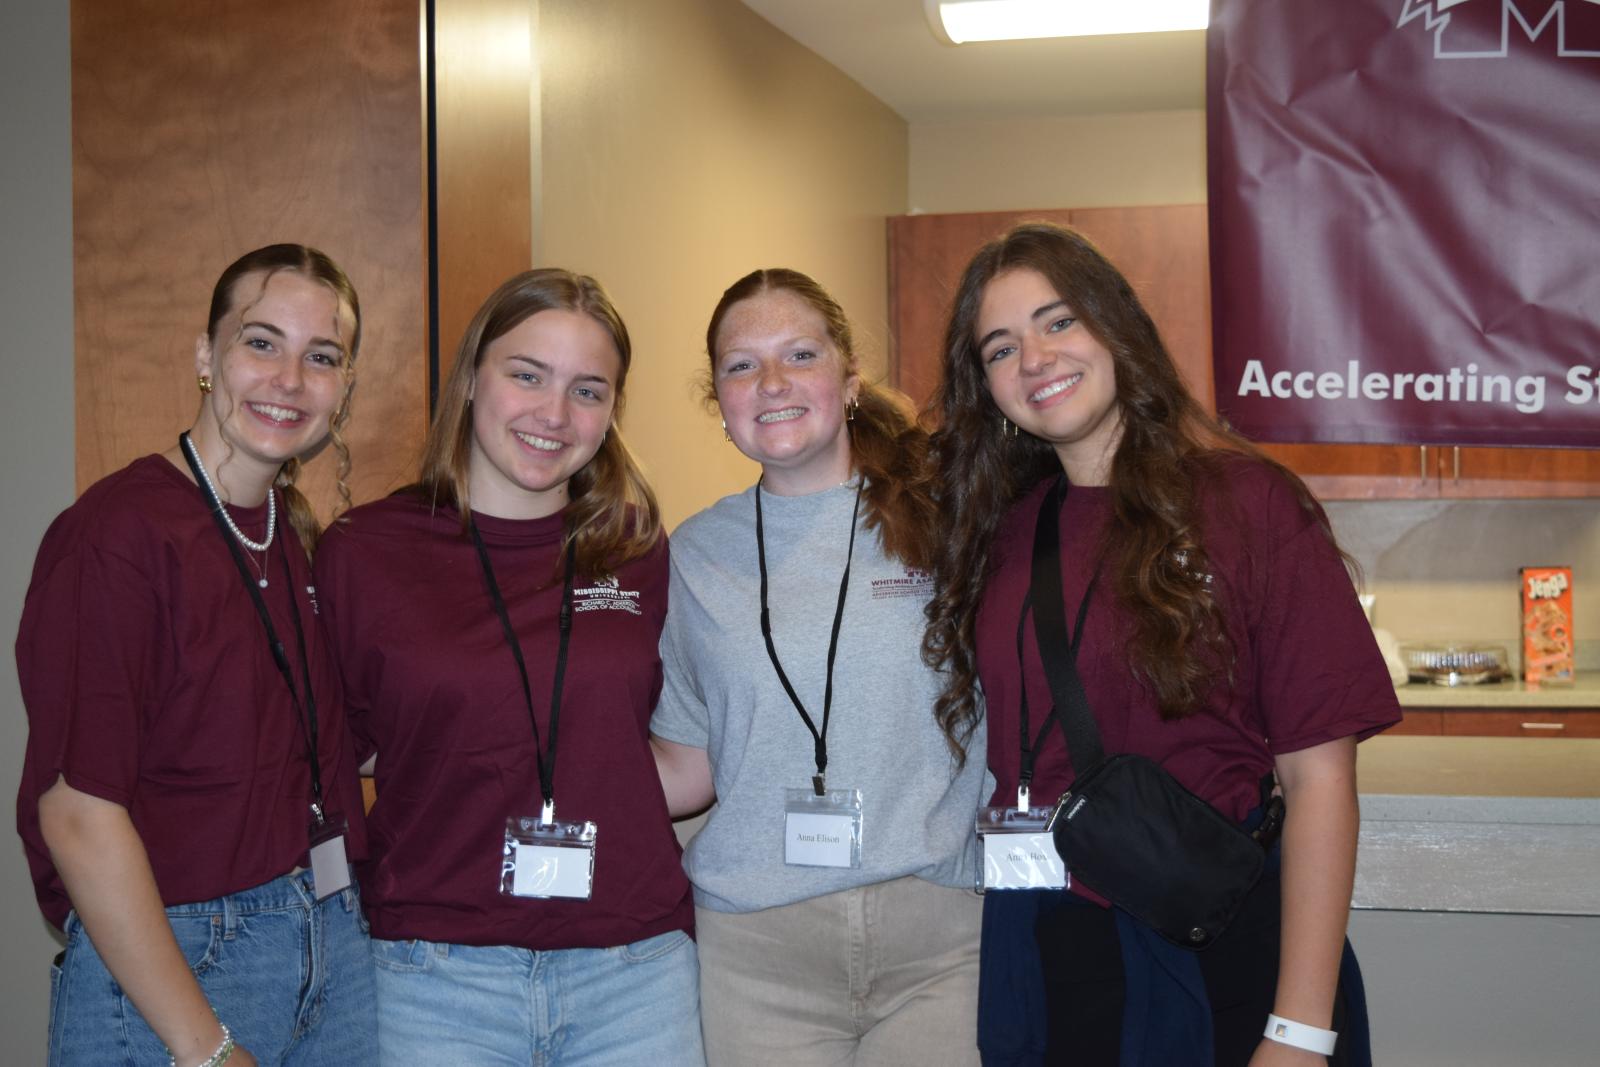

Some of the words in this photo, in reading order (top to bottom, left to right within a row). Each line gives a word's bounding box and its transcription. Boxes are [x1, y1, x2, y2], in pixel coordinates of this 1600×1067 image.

[1237, 359, 1546, 413] Accelerating
[1565, 365, 1600, 404] S
[871, 578, 914, 587] WHITMIRE
[1527, 572, 1568, 599] Jenga
[573, 587, 618, 596] MISSISSIPPI
[797, 833, 815, 842] Anna
